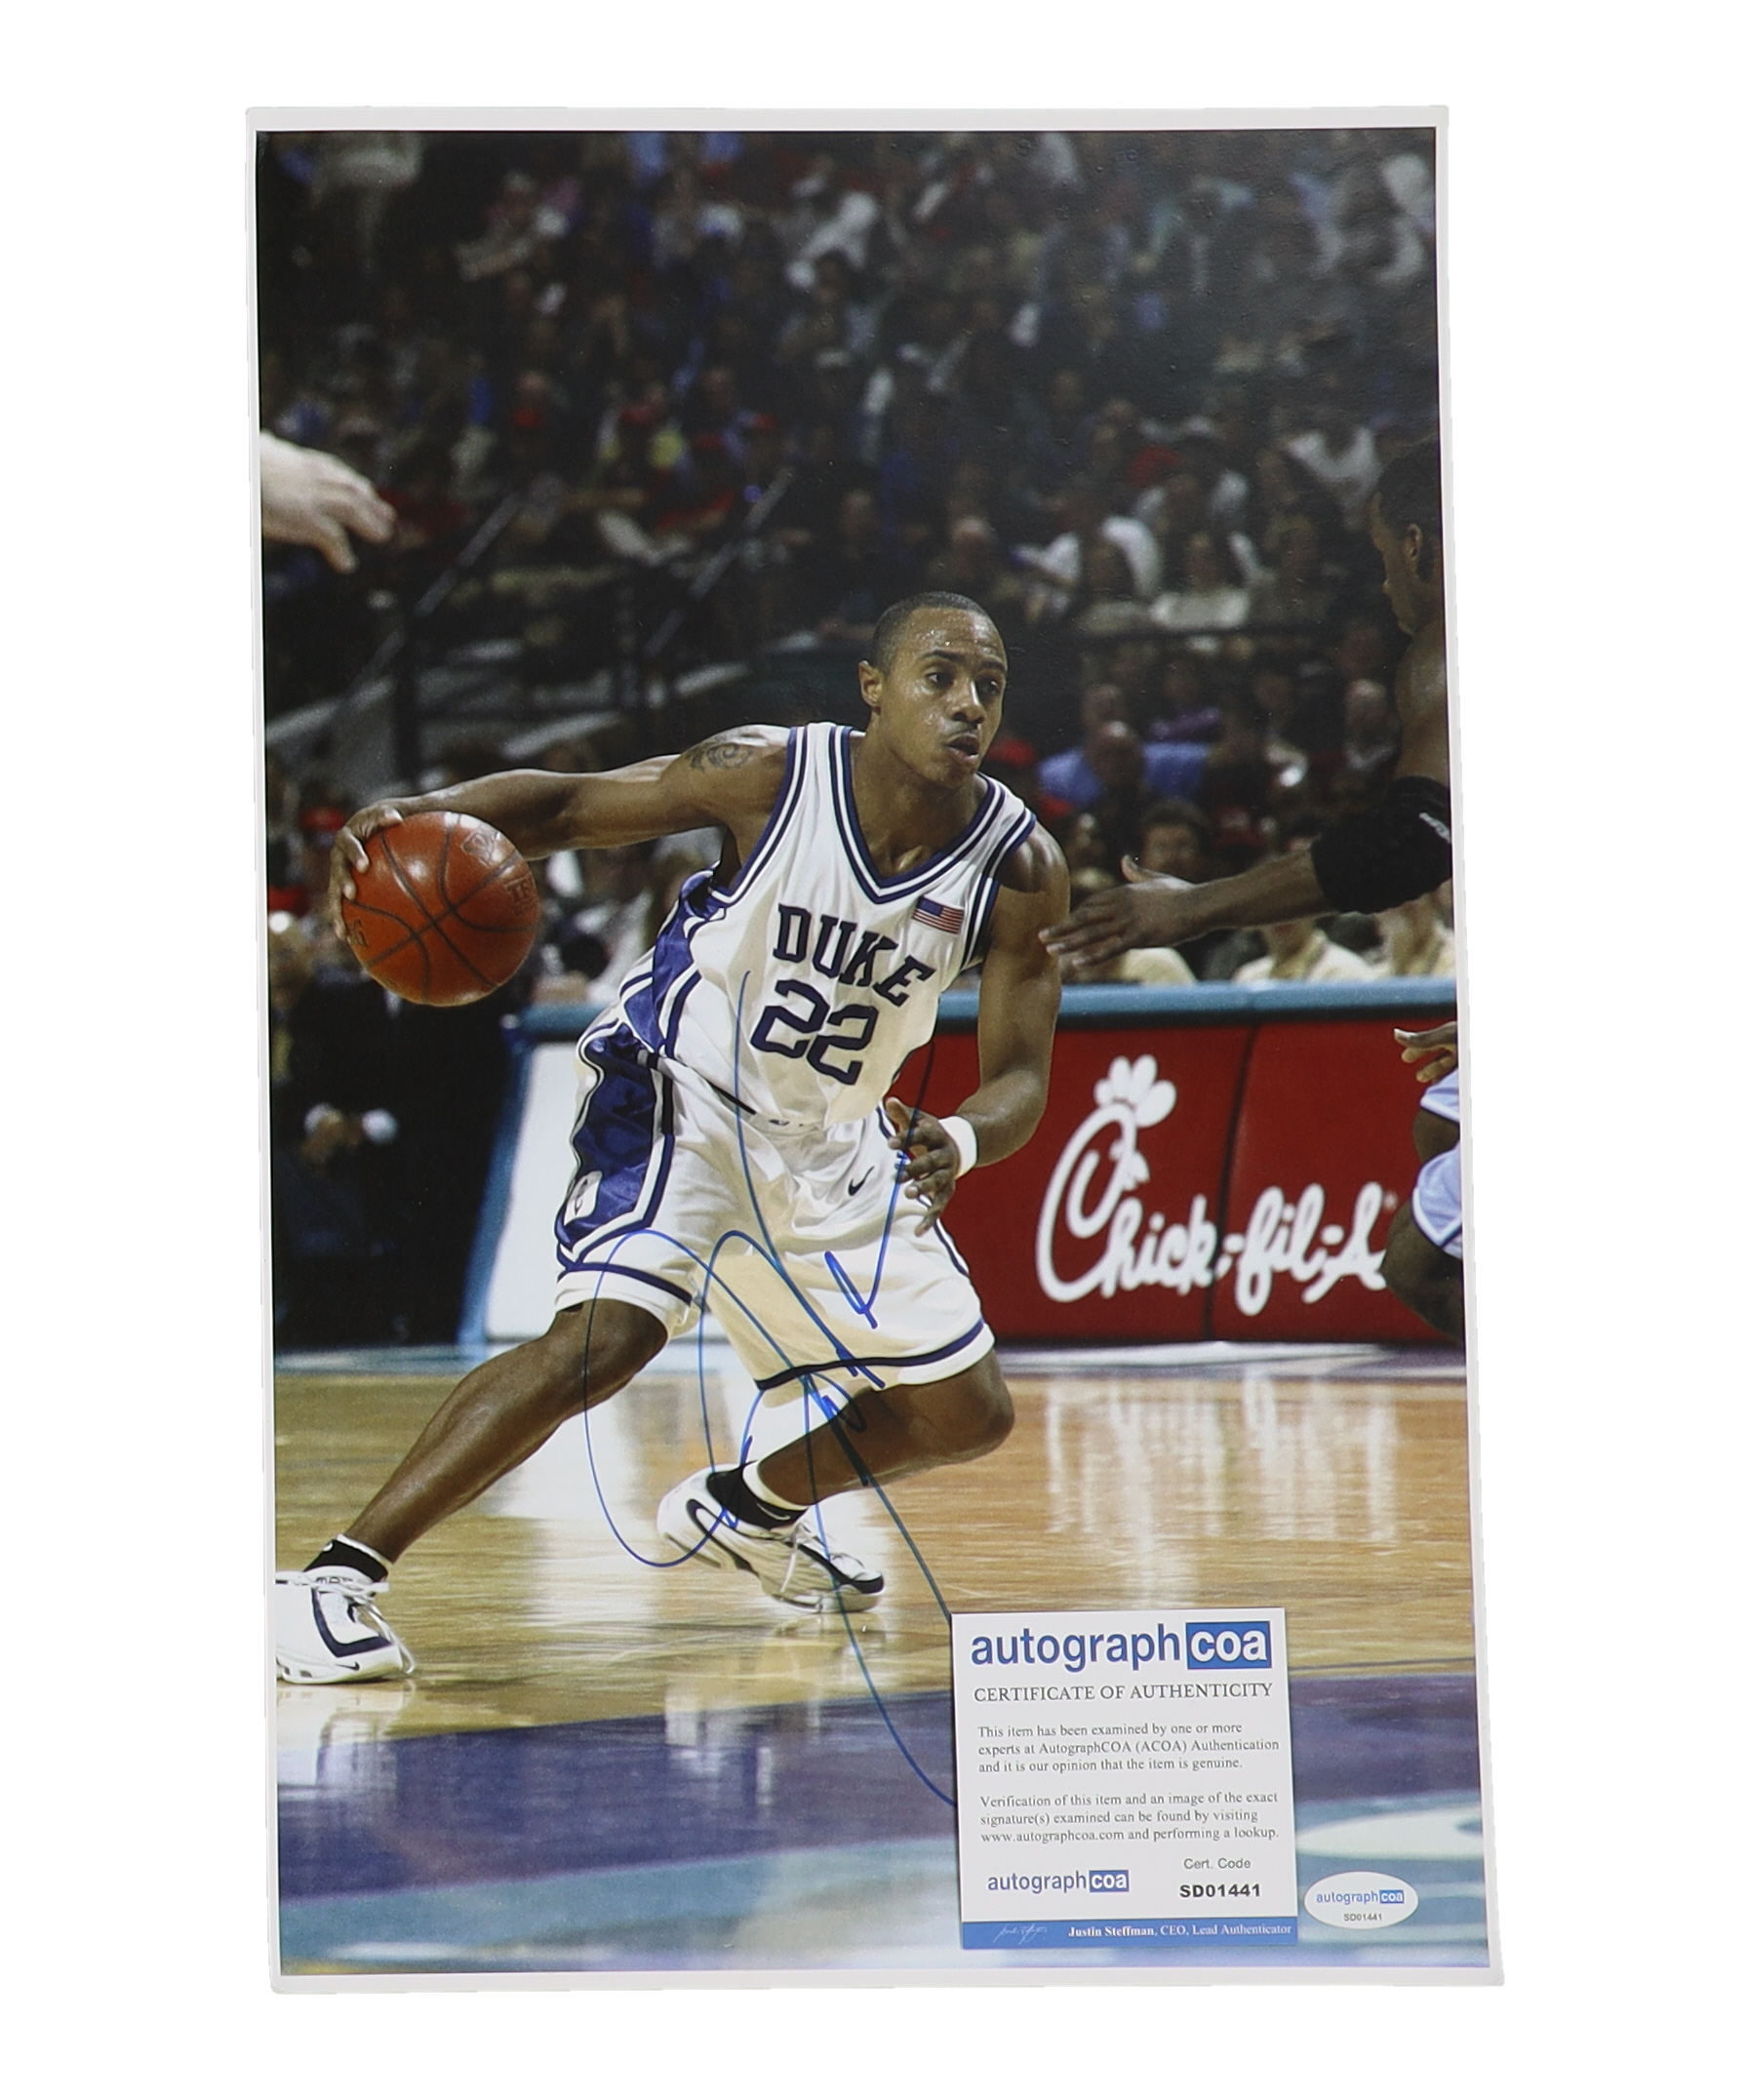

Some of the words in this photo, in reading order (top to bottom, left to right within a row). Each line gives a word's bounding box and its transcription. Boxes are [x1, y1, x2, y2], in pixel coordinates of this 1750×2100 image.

[773, 903, 936, 1008] DUKE
[750, 979, 879, 1086] 22
[1036, 1097, 1387, 1316] Chick-fil-A
[974, 1685, 1095, 1702] CERTIFICATE
[1099, 1684, 1125, 1699] OF
[1129, 1682, 1273, 1699] AUTHENTICITY
[976, 1725, 1004, 1737] This
[1008, 1724, 1033, 1737] item
[1036, 1724, 1056, 1736] has
[1059, 1724, 1088, 1736] been
[1091, 1723, 1148, 1735] examined
[1152, 1722, 1167, 1737] by
[1170, 1724, 1192, 1734] one
[1195, 1724, 1209, 1733] or
[1212, 1724, 1242, 1733] more
[977, 1744, 1020, 1758] experts
[1023, 1744, 1035, 1754] at
[1038, 1740, 1132, 1757] AutographCOA
[1134, 1739, 1187, 1754] (ACOA)
[1190, 1737, 1279, 1751] Authentication
[978, 1760, 1000, 1772] and
[1004, 1760, 1012, 1772] it
[1015, 1760, 1025, 1771] is
[1028, 1763, 1049, 1771] our
[1052, 1759, 1096, 1774] opinion
[1100, 1758, 1123, 1770] that
[1126, 1757, 1144, 1769] the
[1148, 1757, 1174, 1769] item
[1178, 1757, 1188, 1768] is
[1192, 1756, 1243, 1771] genuine.
[979, 1794, 1051, 1807] Verification
[1054, 1794, 1068, 1805] of
[1070, 1794, 1092, 1805] this
[1095, 1793, 1122, 1805] item
[1125, 1792, 1146, 1804] and
[1150, 1795, 1164, 1803] an
[1168, 1791, 1204, 1806] image
[1208, 1791, 1222, 1803] of
[1223, 1791, 1242, 1803] the
[1246, 1792, 1278, 1803] exact
[979, 1812, 1050, 1828] signature(s)
[1053, 1810, 1110, 1823] examined
[1114, 1813, 1134, 1822] can
[1137, 1809, 1152, 1822] be
[1156, 1808, 1191, 1822] found
[1193, 1808, 1209, 1824] by
[1213, 1807, 1258, 1823] visiting
[980, 1828, 1124, 1845] www.autographcoa.com
[1128, 1827, 1149, 1840] and
[1153, 1826, 1220, 1842] performing
[1223, 1829, 1230, 1838] a
[1233, 1825, 1279, 1841] lookup.
[1183, 1857, 1213, 1870] Cert.
[1216, 1856, 1251, 1869] Code
[1179, 1882, 1259, 1898] SD01441
[1068, 1925, 1102, 1937] Justin
[1104, 1924, 1157, 1936] Steffman,
[1160, 1924, 1189, 1935] CEO,
[1191, 1923, 1217, 1934] Lead
[1220, 1922, 1292, 1934] Authenticator
